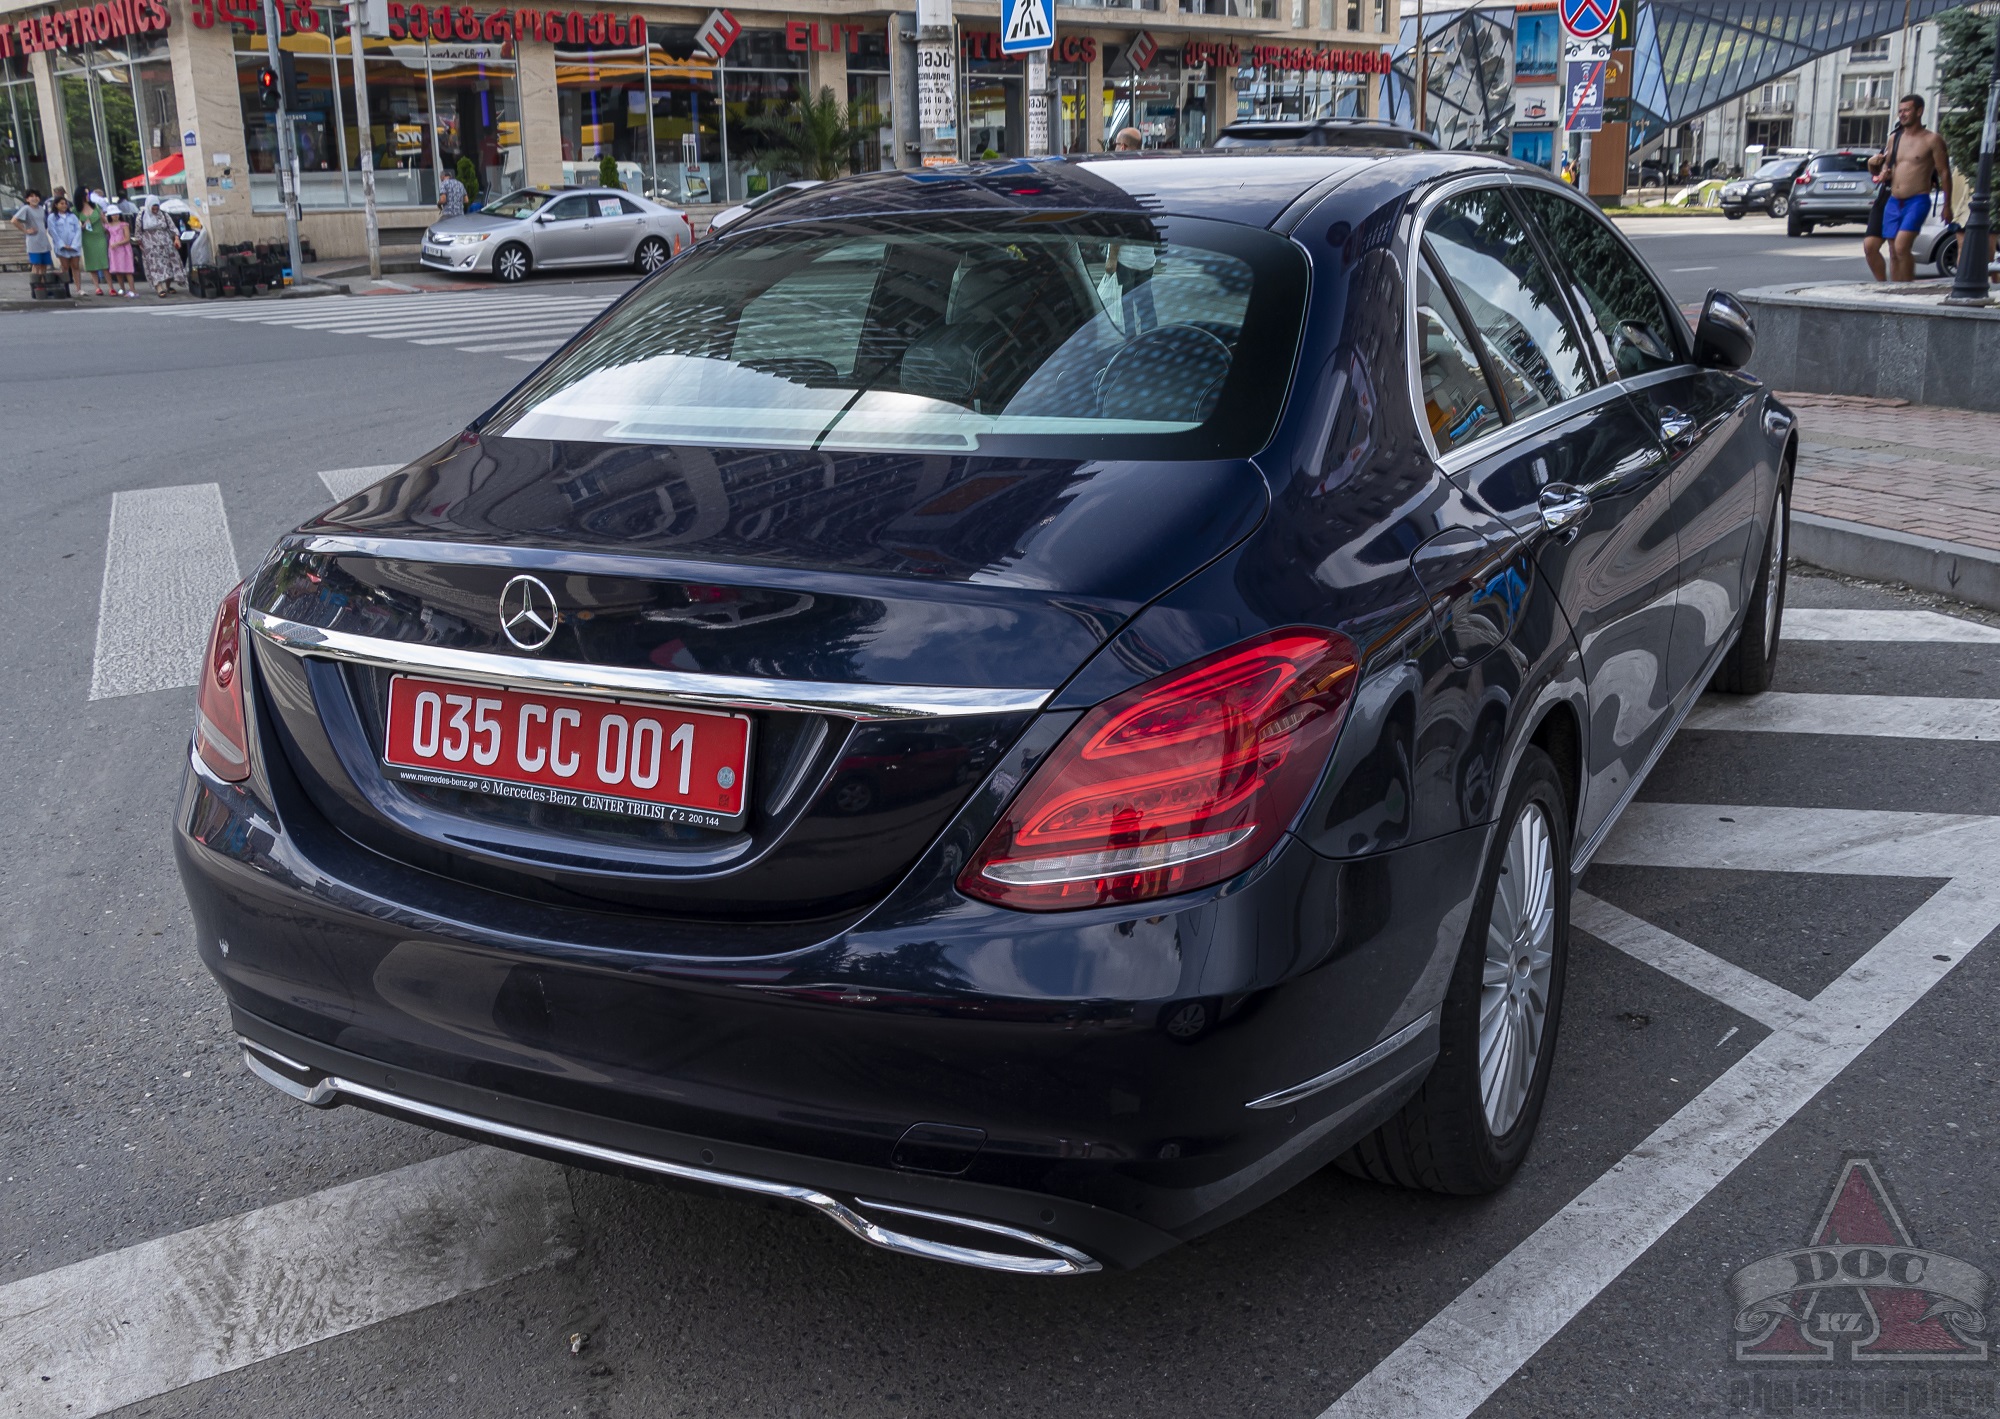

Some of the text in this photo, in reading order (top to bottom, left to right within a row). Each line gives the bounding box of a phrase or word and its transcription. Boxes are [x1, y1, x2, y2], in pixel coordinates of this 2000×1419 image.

[18, 0, 171, 54] ELECTRONICS
[343, 0, 647, 46] ექტრონიქსი
[785, 21, 864, 54] ELIT
[1185, 40, 1392, 75] ელიტ ელექტრონიქსი
[412, 690, 695, 795] 035 CC 001
[400, 771, 719, 827] www.mercedes-benz.ge Mercedes-Benz CENTER TBILISI 2 200 144
